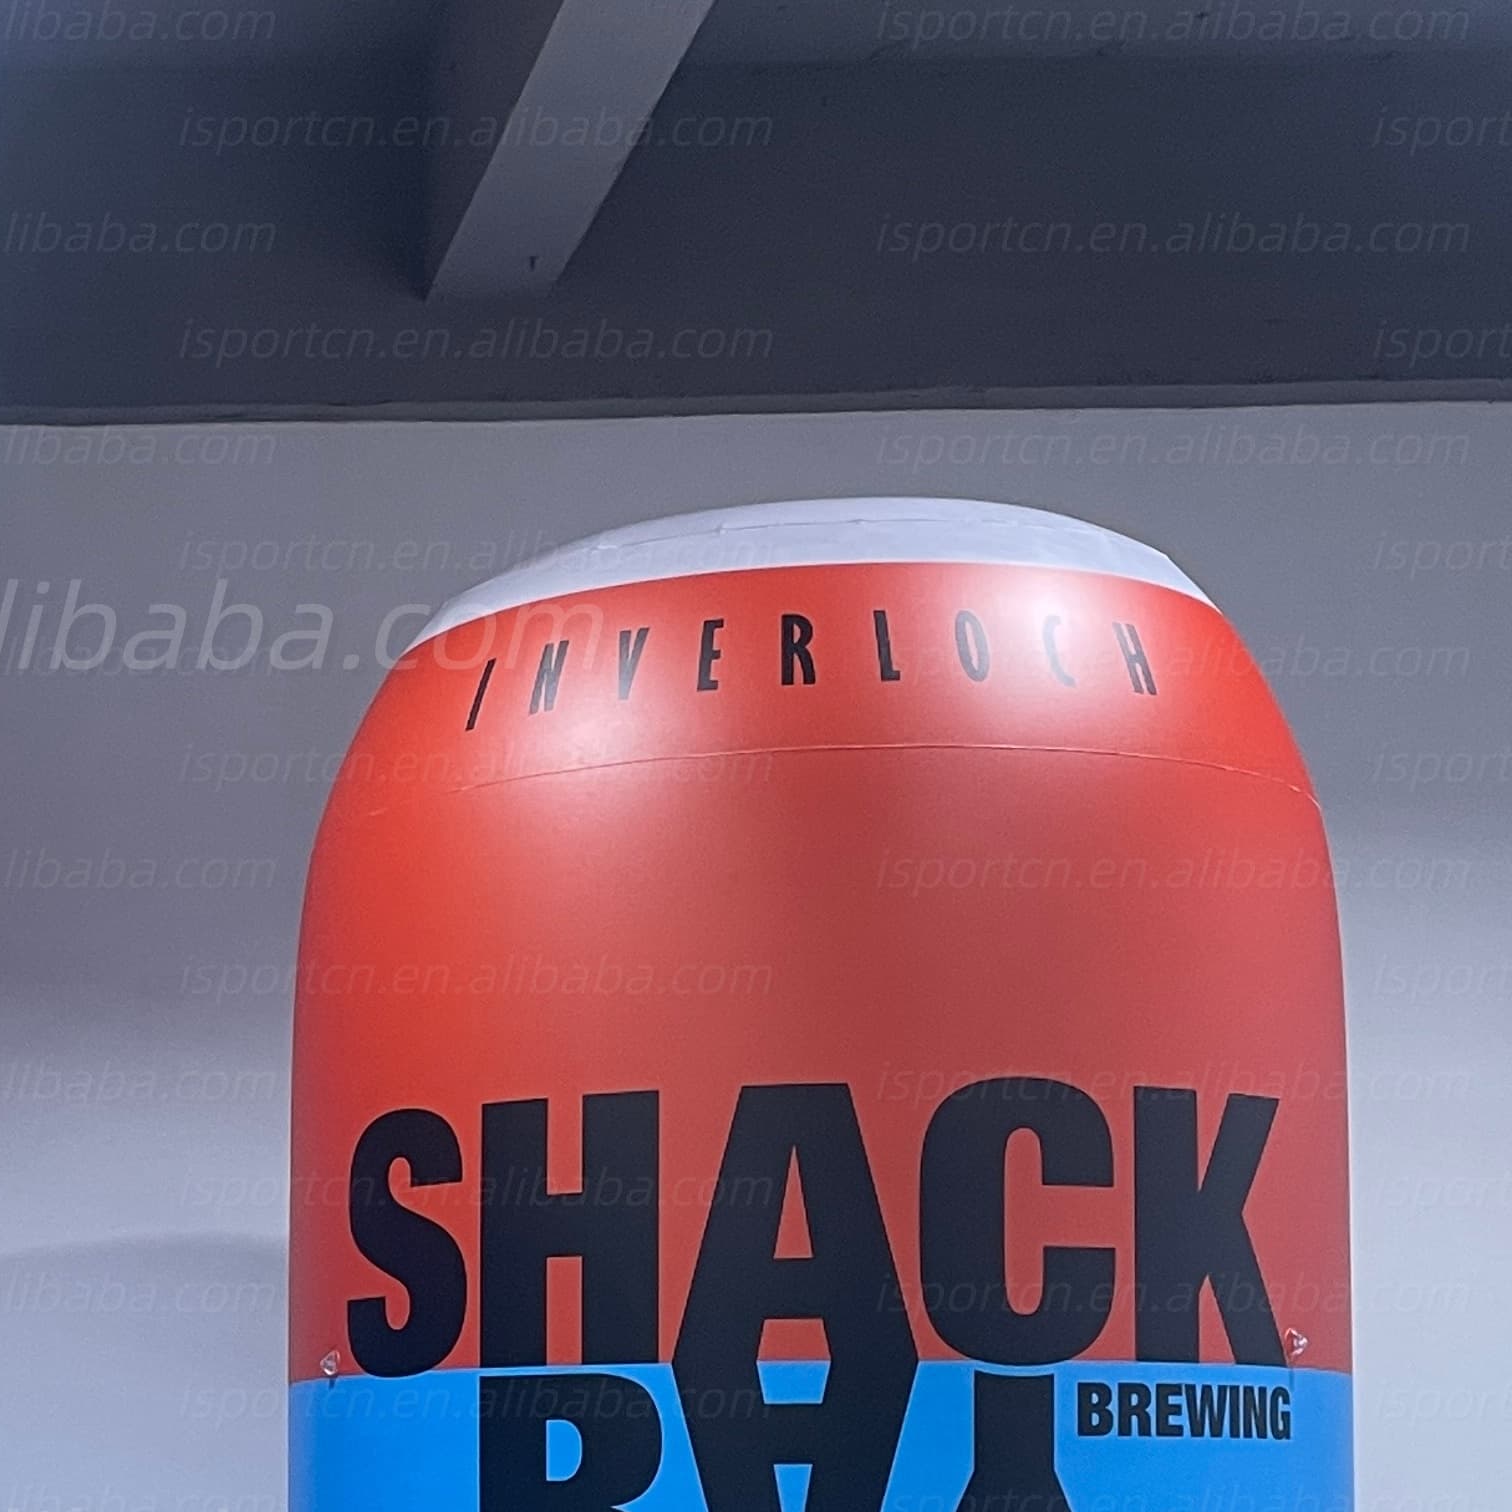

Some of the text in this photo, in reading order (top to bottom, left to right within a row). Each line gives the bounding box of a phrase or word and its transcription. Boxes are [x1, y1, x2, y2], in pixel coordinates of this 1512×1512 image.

[464, 609, 1159, 732] INVERLOCH
[345, 1075, 1289, 1379] SHACK
[1075, 1380, 1293, 1441] BREWING
